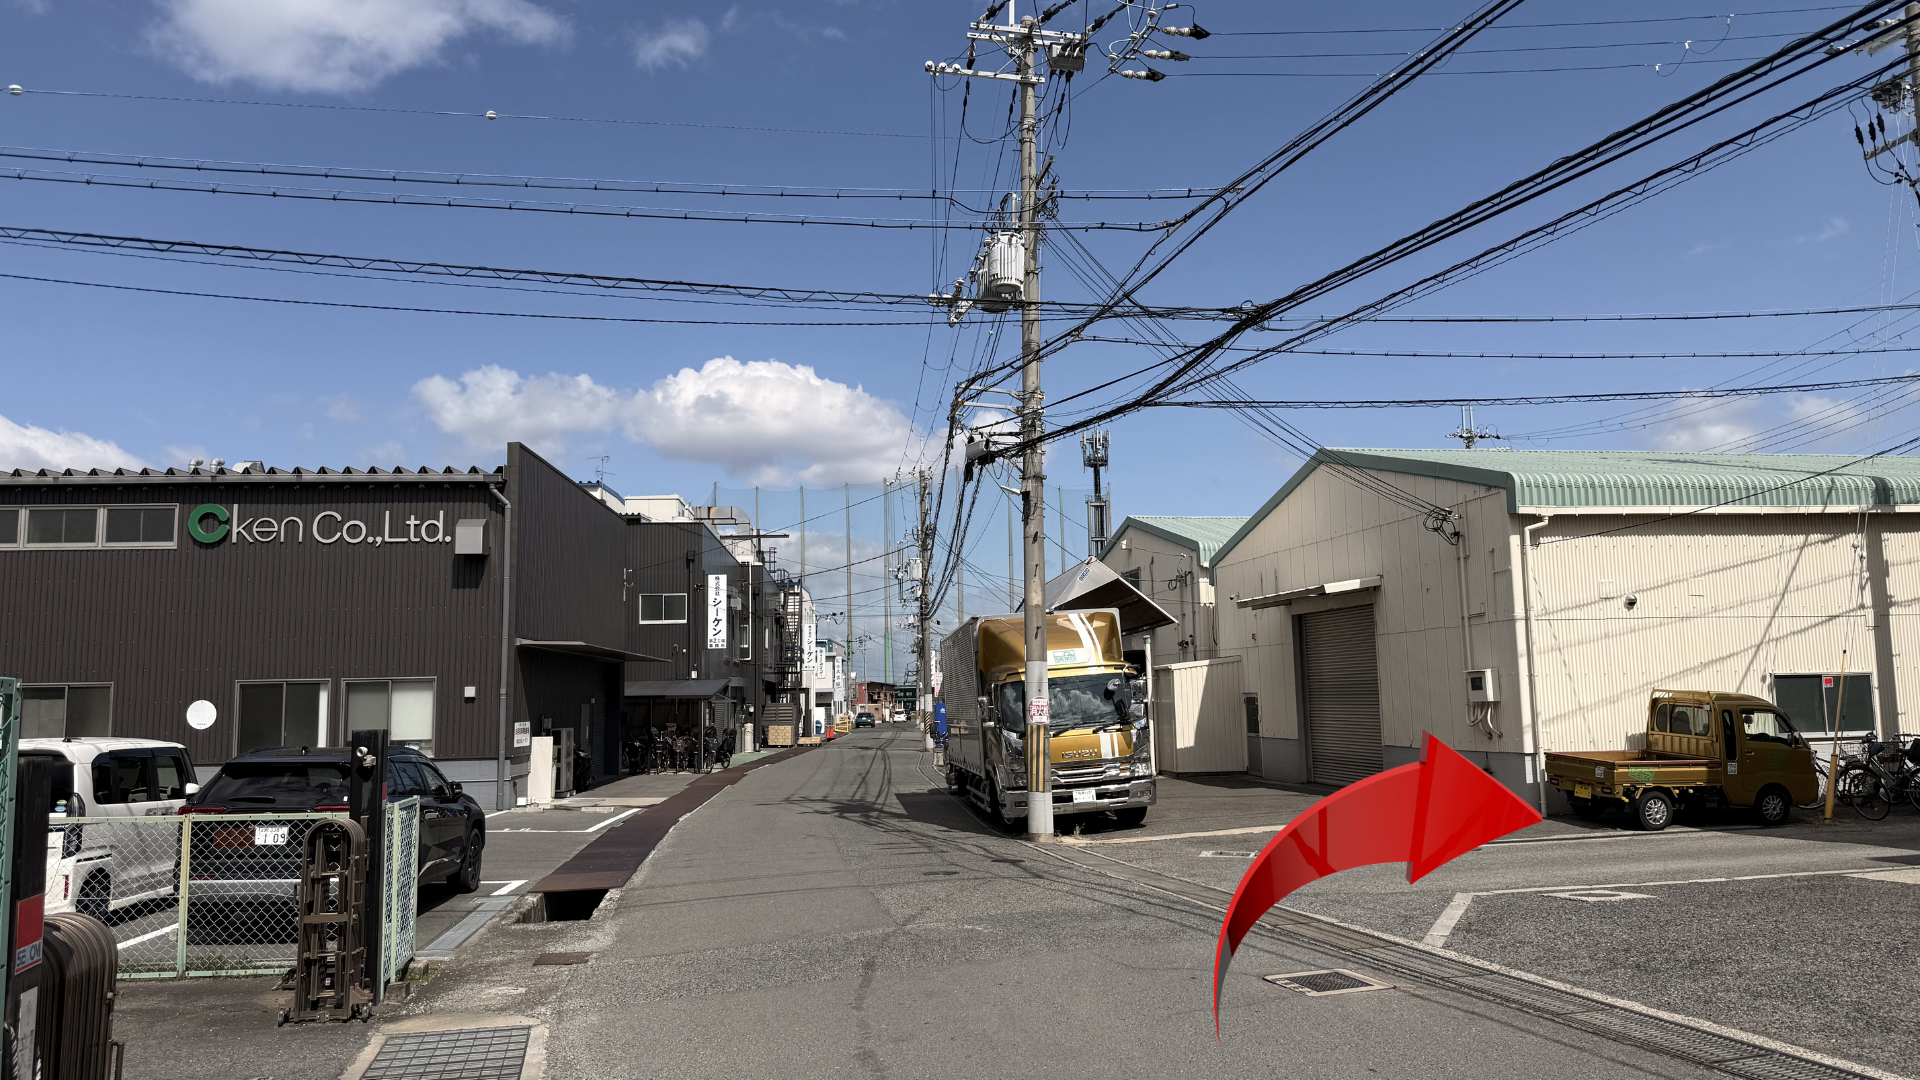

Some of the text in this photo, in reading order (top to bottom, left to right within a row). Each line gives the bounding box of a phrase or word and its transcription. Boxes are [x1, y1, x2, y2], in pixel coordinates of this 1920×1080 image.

[188, 503, 452, 547] Cken Co.,Ltd.
[712, 598, 722, 637] シーケン
[1061, 748, 1098, 759] ISUZU
